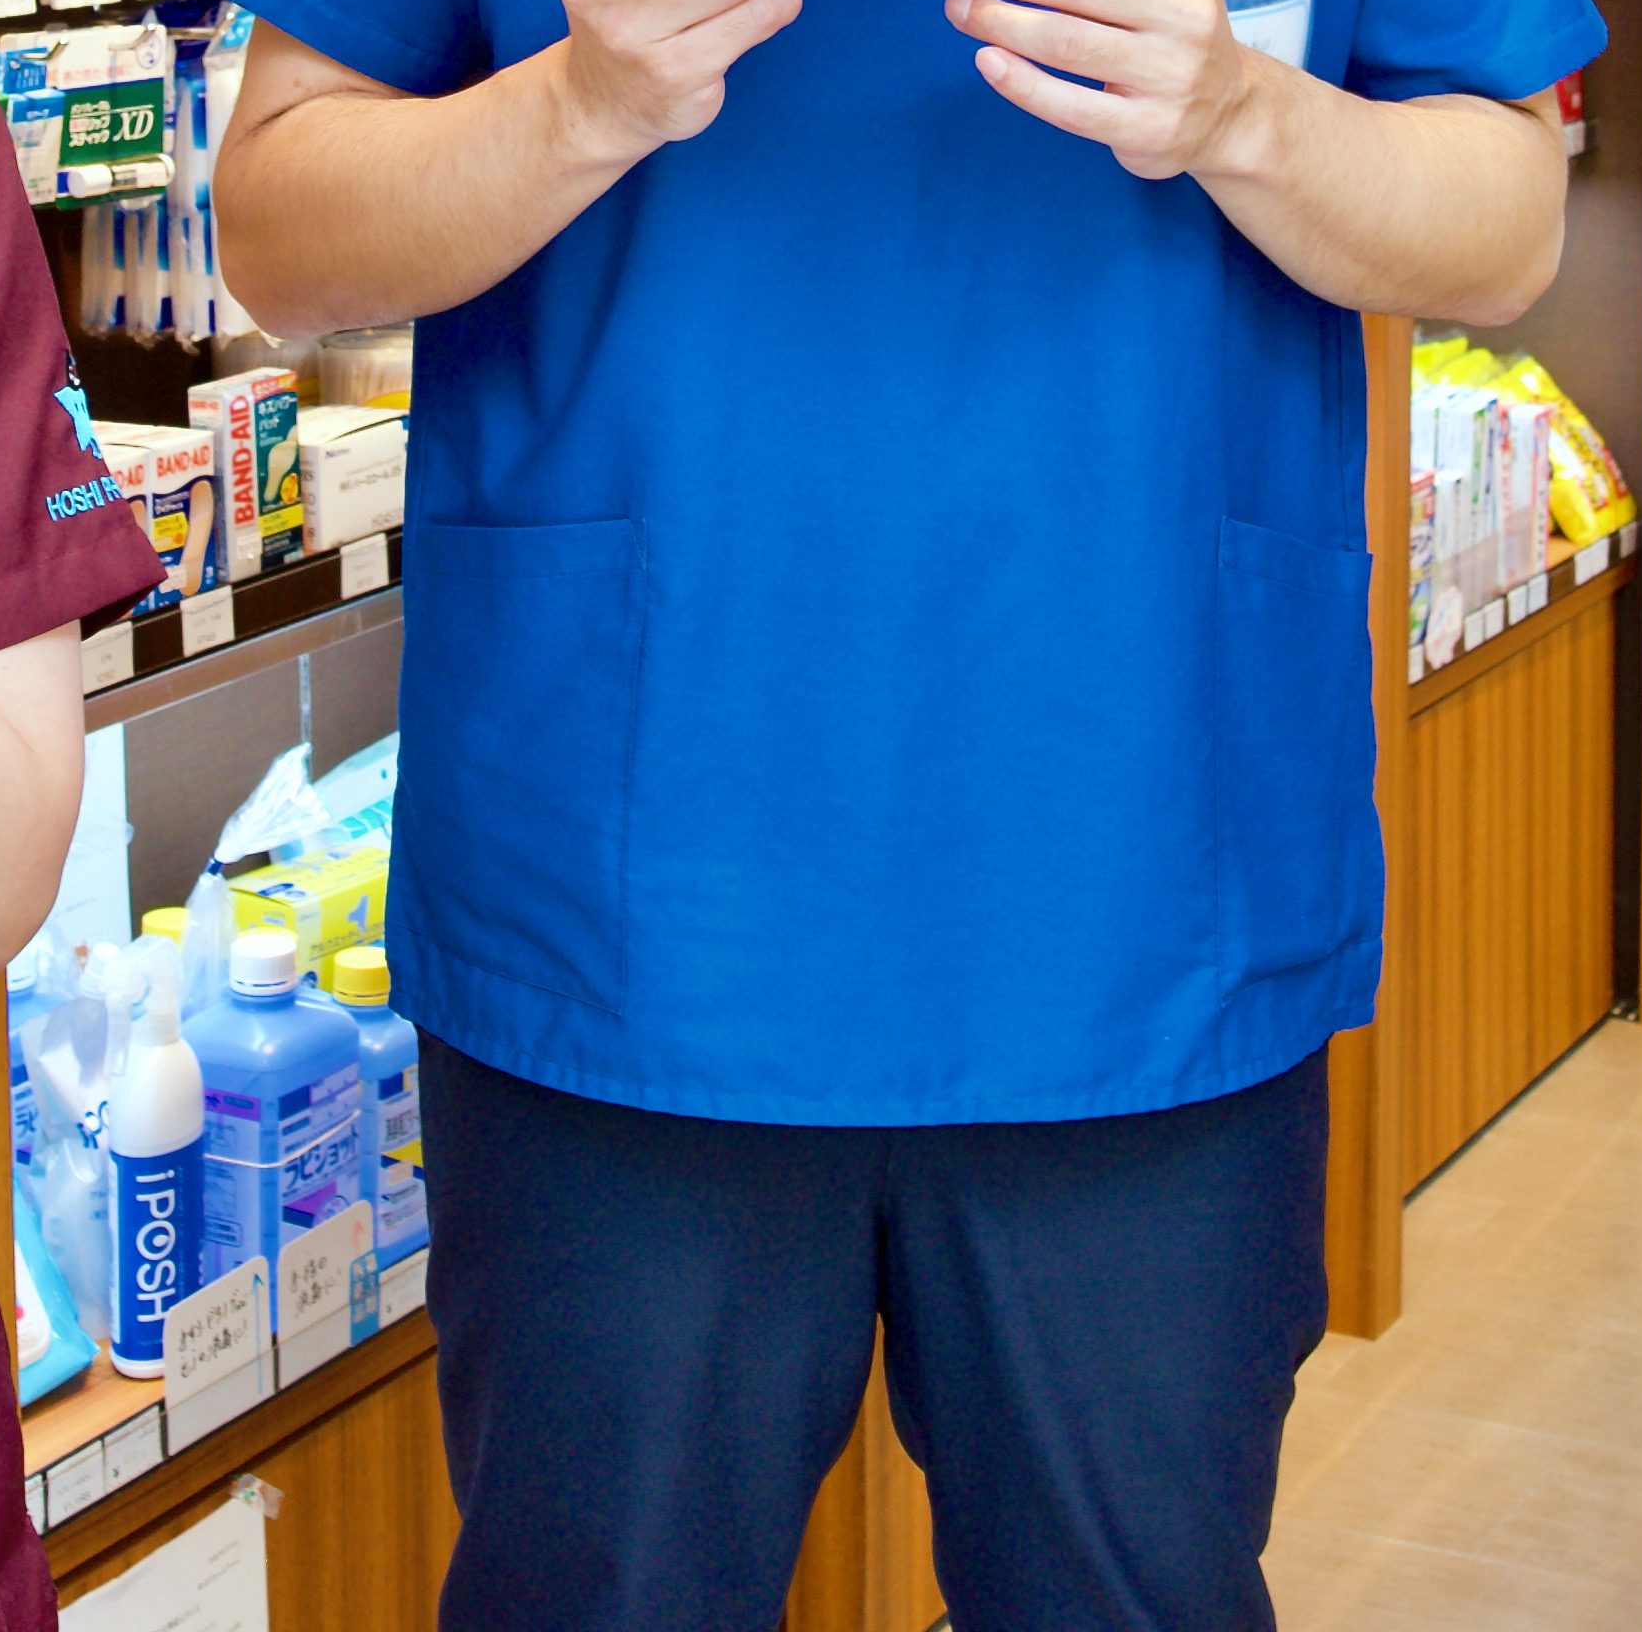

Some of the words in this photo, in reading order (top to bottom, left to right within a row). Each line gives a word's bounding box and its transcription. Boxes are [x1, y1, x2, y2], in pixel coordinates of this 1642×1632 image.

[112, 106, 155, 143] XD
[156, 445, 210, 478] BAND-AID
[229, 394, 256, 526] BAND-AID
[48, 483, 105, 521] HOSHI
